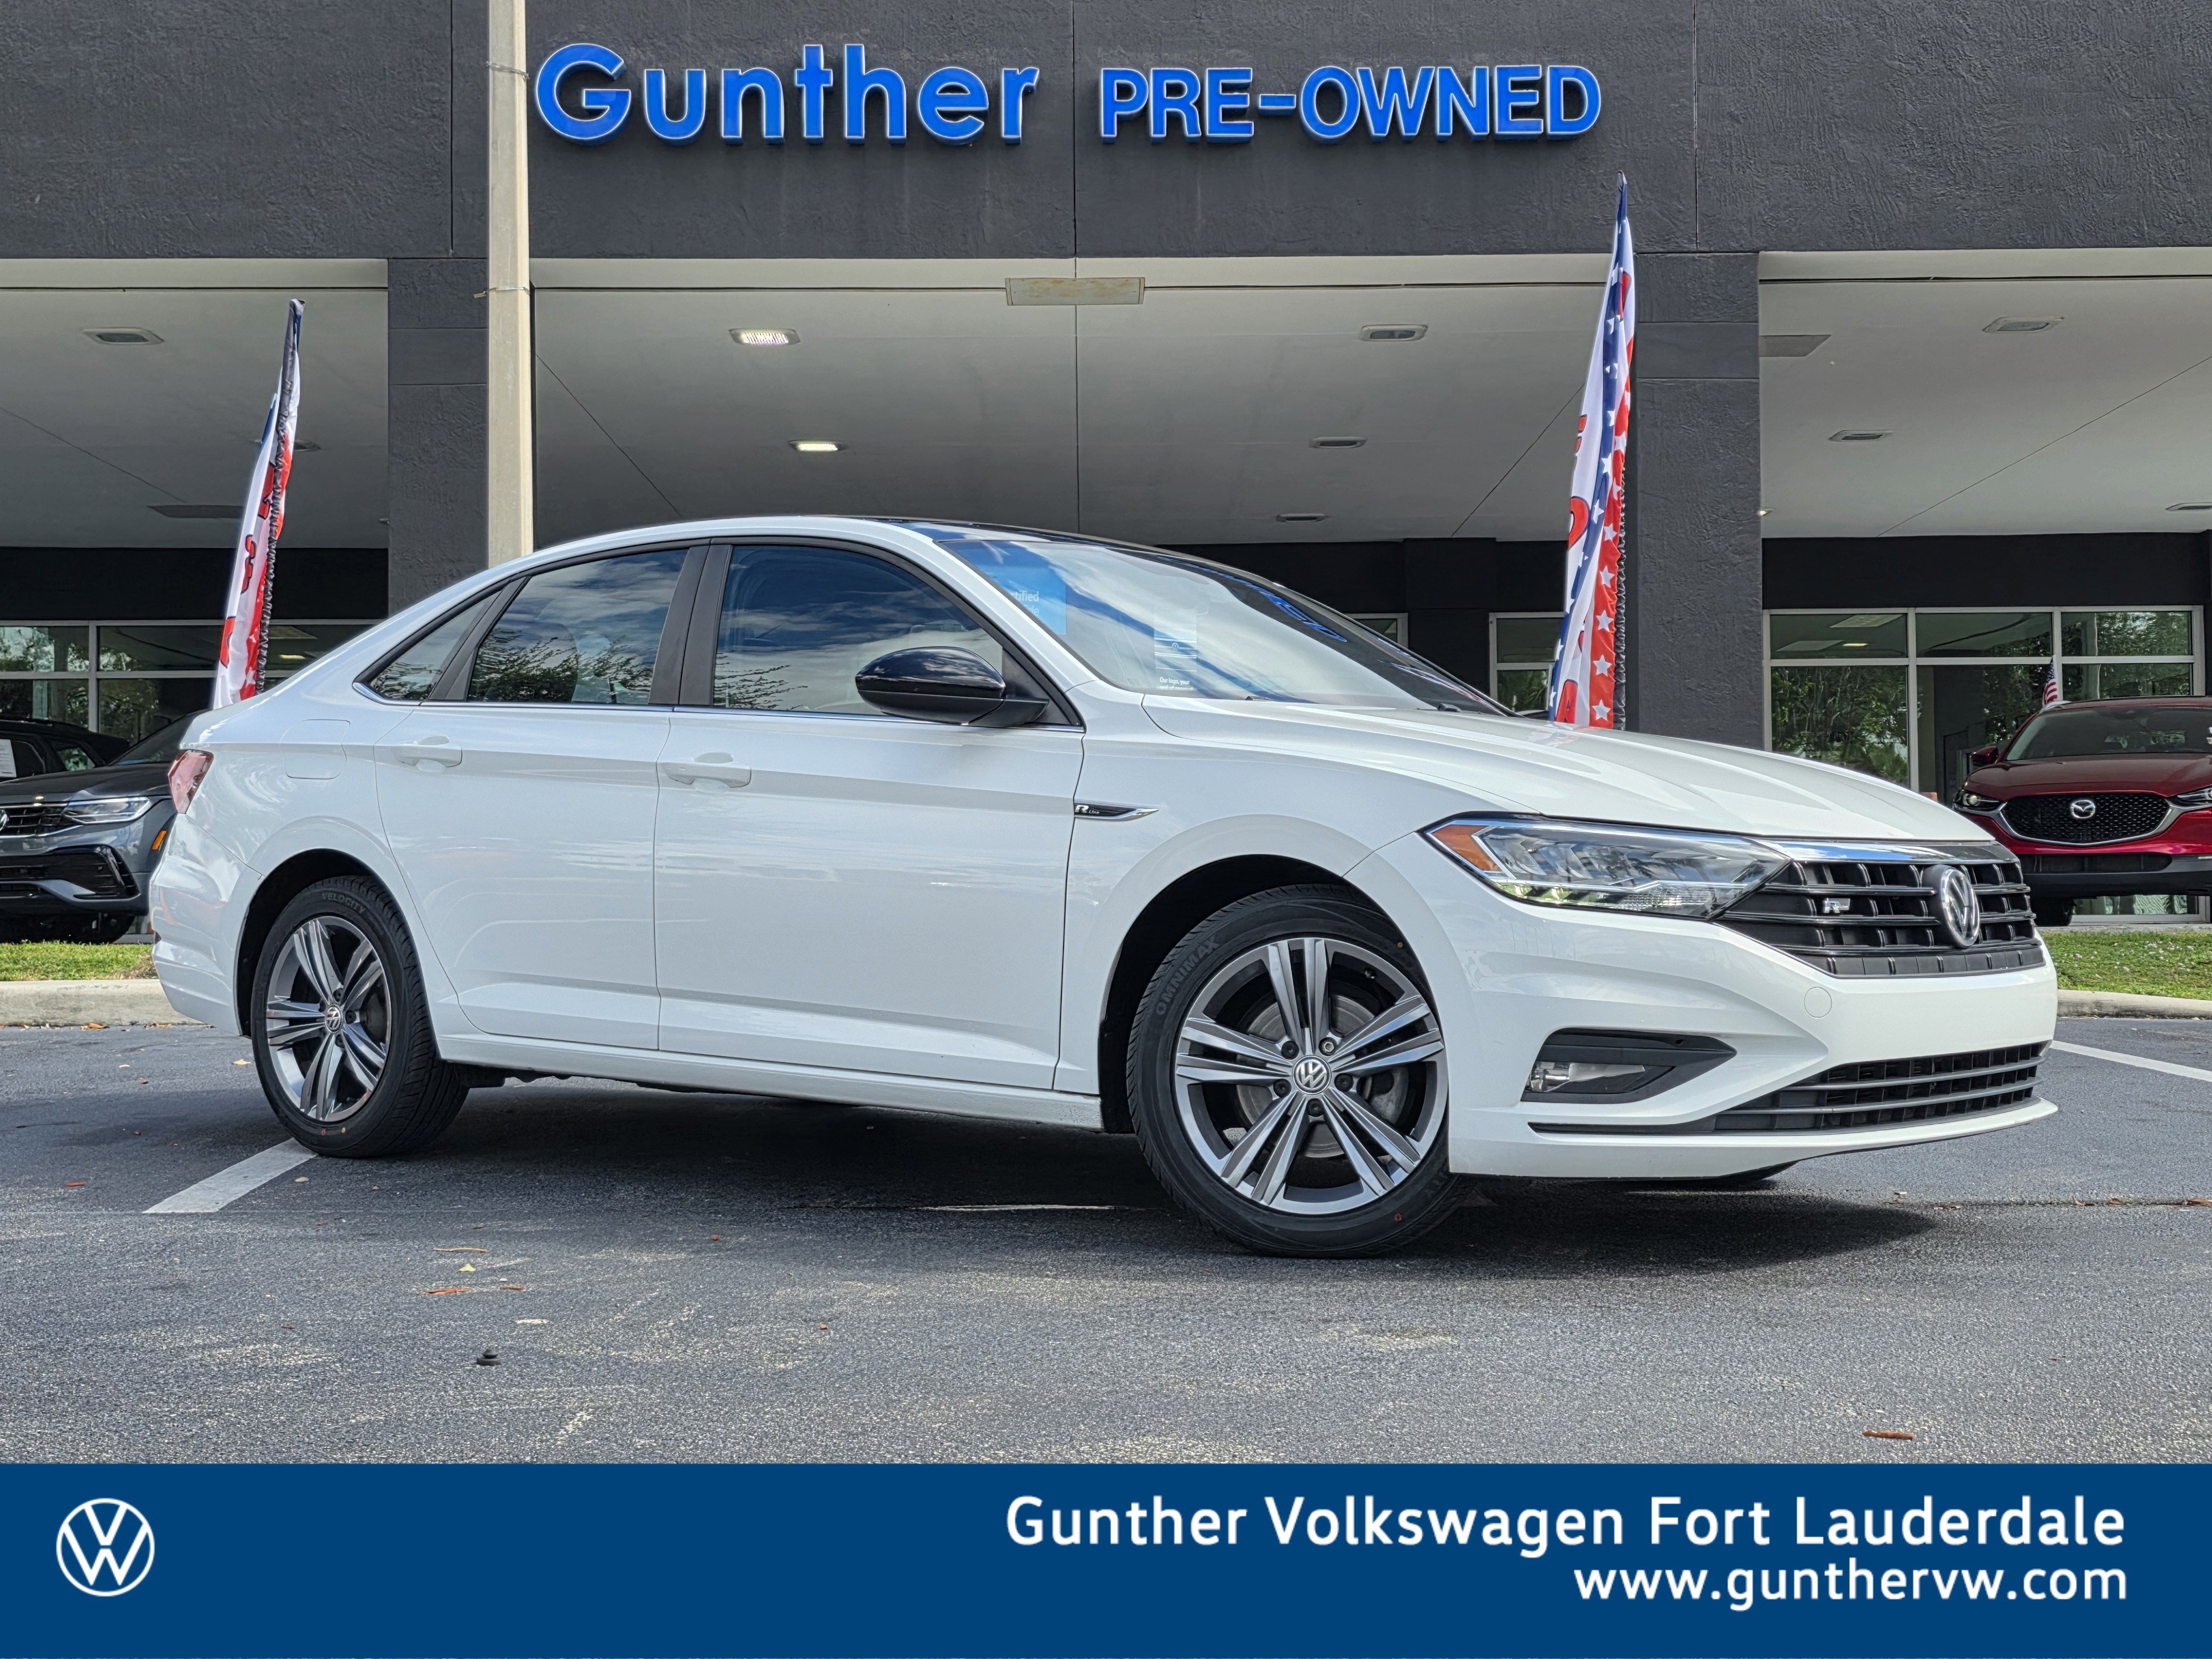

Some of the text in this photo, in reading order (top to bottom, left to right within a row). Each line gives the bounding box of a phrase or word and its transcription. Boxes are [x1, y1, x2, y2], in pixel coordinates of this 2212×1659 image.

[536, 43, 1601, 145] Gunther PRE-OWNED
[1075, 805, 1089, 813] R
[322, 893, 366, 914] VELOCITY
[1156, 935, 1220, 1015] OMNIMAX
